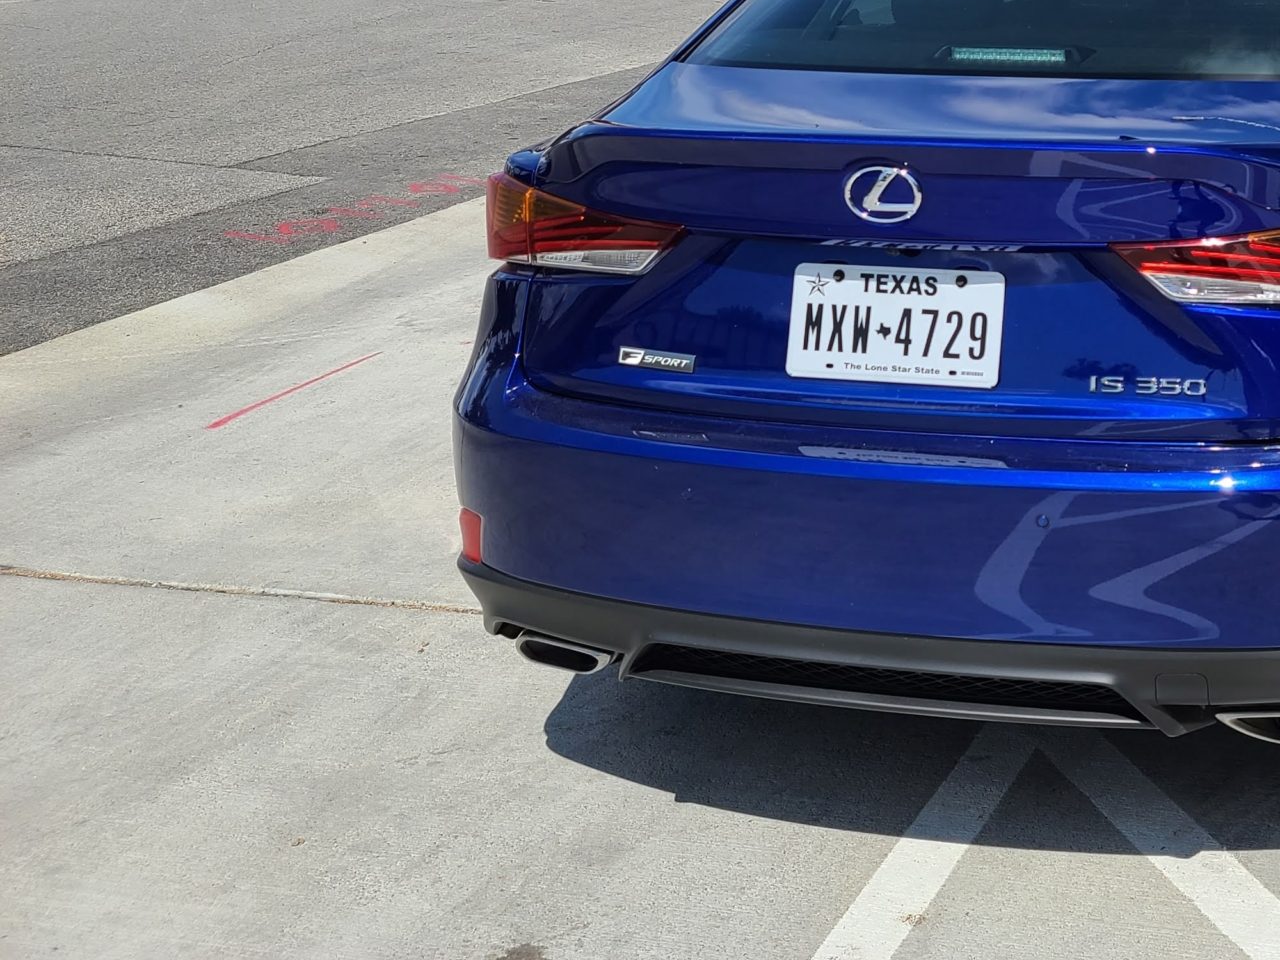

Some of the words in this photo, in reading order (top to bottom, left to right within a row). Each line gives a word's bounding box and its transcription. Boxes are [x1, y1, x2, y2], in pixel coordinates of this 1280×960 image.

[860, 273, 938, 296] TEXAS
[643, 354, 690, 368] SPORT
[844, 362, 862, 371] The
[865, 363, 888, 372] Lone
[891, 365, 911, 374] Star
[914, 366, 940, 375] State
[1089, 375, 1124, 393] IS
[1136, 377, 1206, 396] 350
